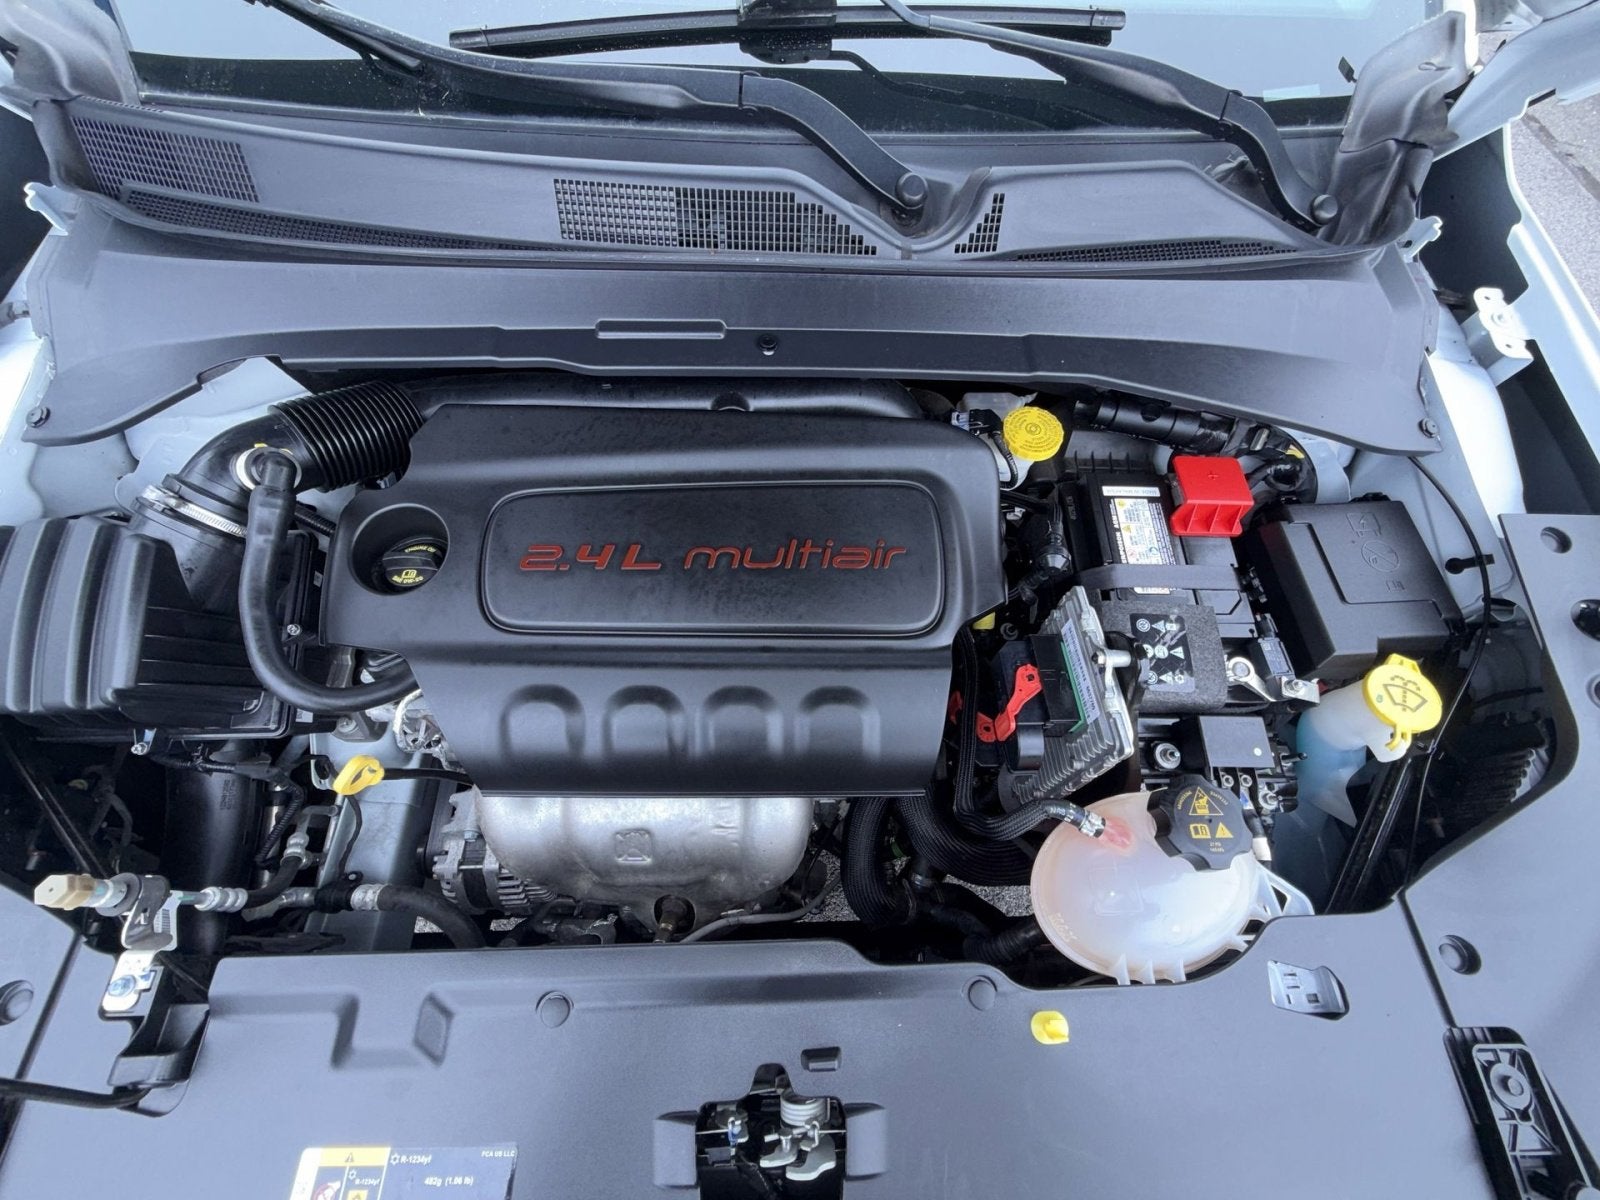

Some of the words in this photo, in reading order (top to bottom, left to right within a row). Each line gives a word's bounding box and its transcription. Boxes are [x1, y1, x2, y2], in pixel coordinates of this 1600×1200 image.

[683, 537, 907, 570] multiair
[399, 1154, 432, 1165] R-1234yf
[355, 1178, 381, 1186] R-1234yf
